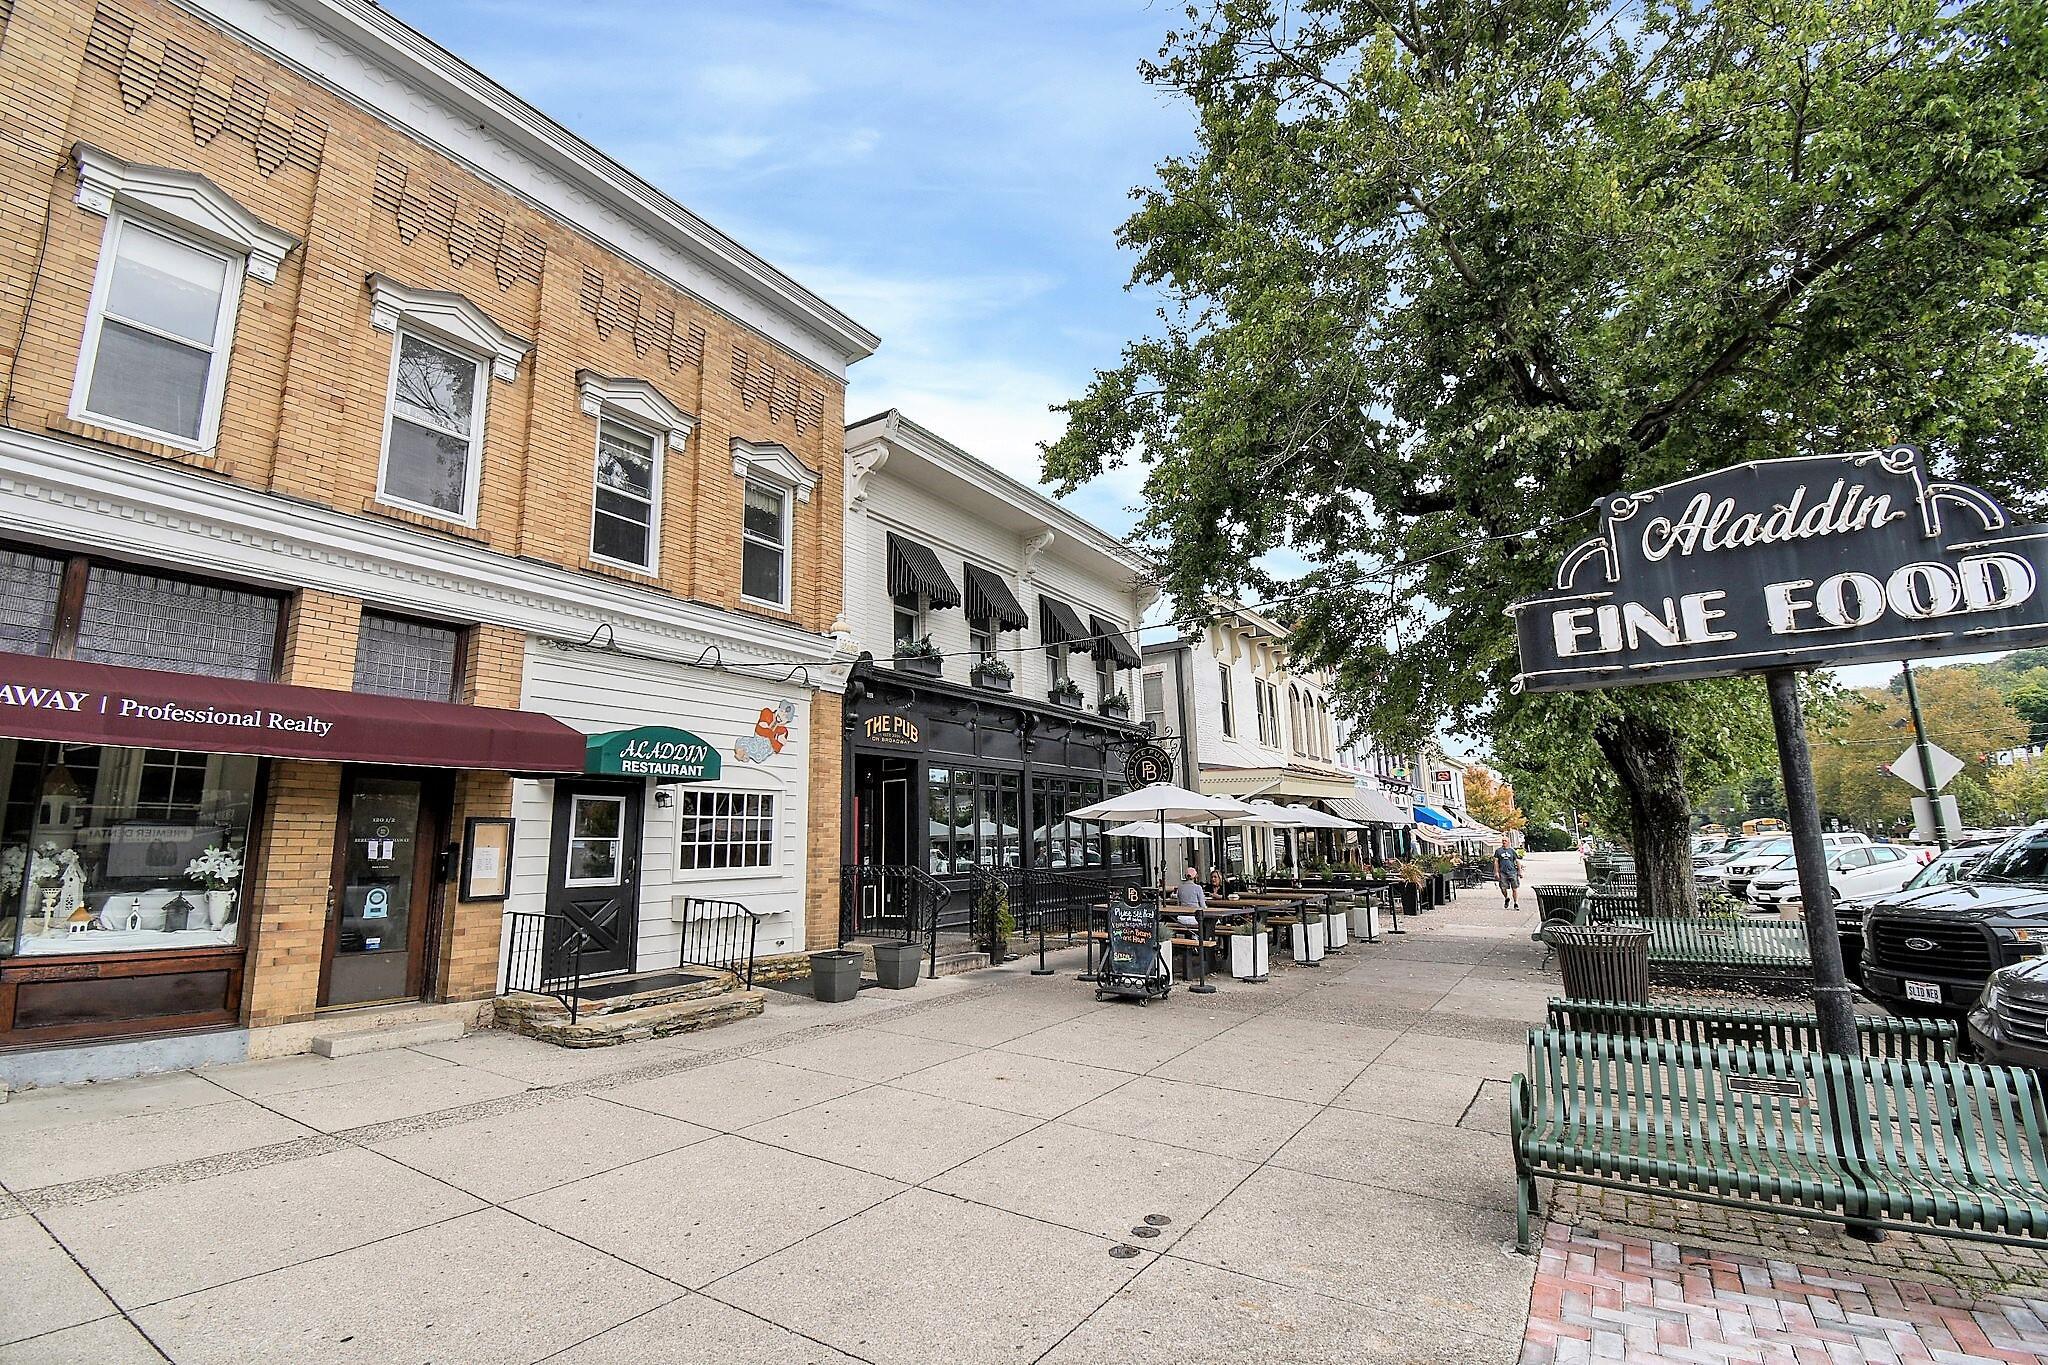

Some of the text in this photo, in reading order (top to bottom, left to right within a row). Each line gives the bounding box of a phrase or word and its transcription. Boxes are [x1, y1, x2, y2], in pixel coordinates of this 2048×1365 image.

[1642, 478, 1905, 562] Aladdin
[1551, 551, 2037, 658] FINE FOOD
[118, 698, 262, 728] Professional
[267, 711, 334, 737] Realty
[864, 715, 920, 743] THE PUB
[619, 739, 708, 764] ALADDIN
[621, 760, 705, 777] RESTAURANT
